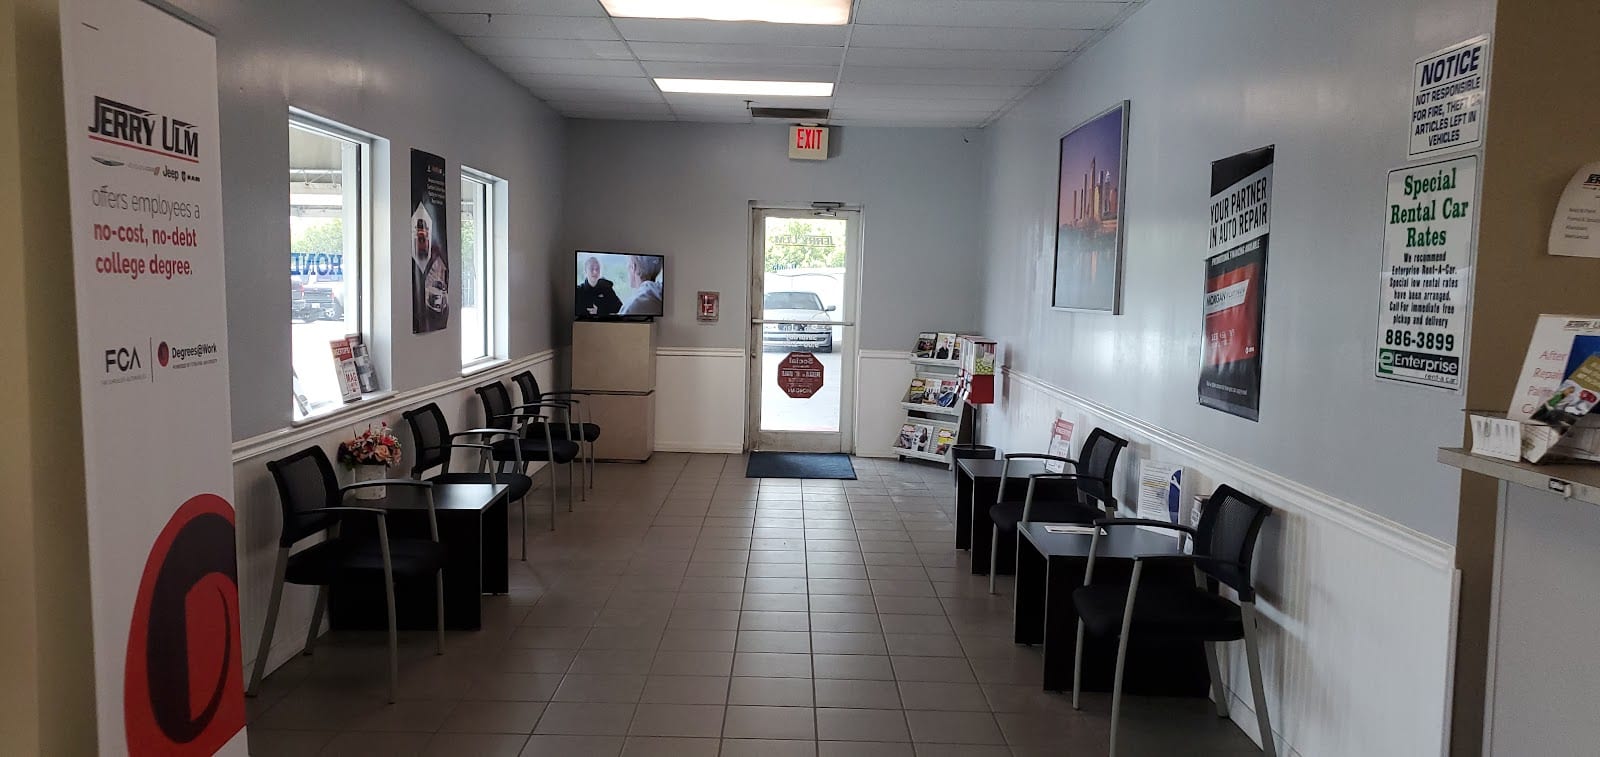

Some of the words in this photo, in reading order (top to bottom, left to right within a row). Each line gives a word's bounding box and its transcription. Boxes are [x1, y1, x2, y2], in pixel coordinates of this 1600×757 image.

[1420, 46, 1482, 87] NOTICE
[1415, 92, 1431, 107] NOT
[1431, 77, 1481, 102] RESPONSIBLE
[1412, 110, 1427, 122] FOR
[1427, 104, 1445, 118] FIRE,
[1446, 97, 1468, 113] THEFT
[88, 95, 158, 147] JERRY
[162, 116, 199, 158] ULM
[1414, 118, 1449, 136] ARTICLES
[1449, 112, 1467, 128] LEFT
[1468, 110, 1477, 123] IN
[796, 128, 823, 150] EXIT
[1428, 129, 1460, 147] VEHICLES
[162, 165, 179, 182] Jeep
[1403, 167, 1457, 200] Special
[91, 184, 129, 210] offers
[131, 195, 192, 220] employees
[194, 203, 200, 219] a
[1210, 197, 1229, 226] YOUR
[1231, 177, 1267, 215] PARTNER
[1389, 199, 1436, 225] Rental
[1443, 197, 1469, 219] Car
[93, 223, 149, 246] no-cost,
[152, 226, 198, 248] no-debt
[1209, 227, 1218, 249] IN
[1218, 218, 1237, 245] AUTO
[1239, 202, 1268, 236] REPAIR
[1406, 226, 1447, 248] Rates
[95, 251, 145, 280] college
[149, 254, 193, 280] degree.
[1403, 252, 1412, 263] We
[1413, 251, 1447, 263] recommend
[1392, 265, 1420, 277] Enterprise
[1421, 263, 1457, 276] Rent-A-Car.
[1389, 277, 1409, 289] Special
[1410, 278, 1420, 288] low
[1422, 278, 1441, 288] rental
[1442, 278, 1458, 288] rates
[1389, 301, 1400, 312] Call
[1410, 302, 1440, 313] immediate
[1442, 303, 1455, 314] free
[1393, 289, 1406, 300] have
[1408, 290, 1422, 300] been
[1423, 290, 1451, 303] arranged.
[1393, 314, 1411, 326] pickup
[1412, 315, 1423, 325] and
[1424, 315, 1448, 329] delivery
[1385, 328, 1455, 352] 886-3899
[105, 345, 142, 373] FCA
[171, 342, 218, 360] Degrees@Work
[1394, 353, 1458, 374] Enterprise
